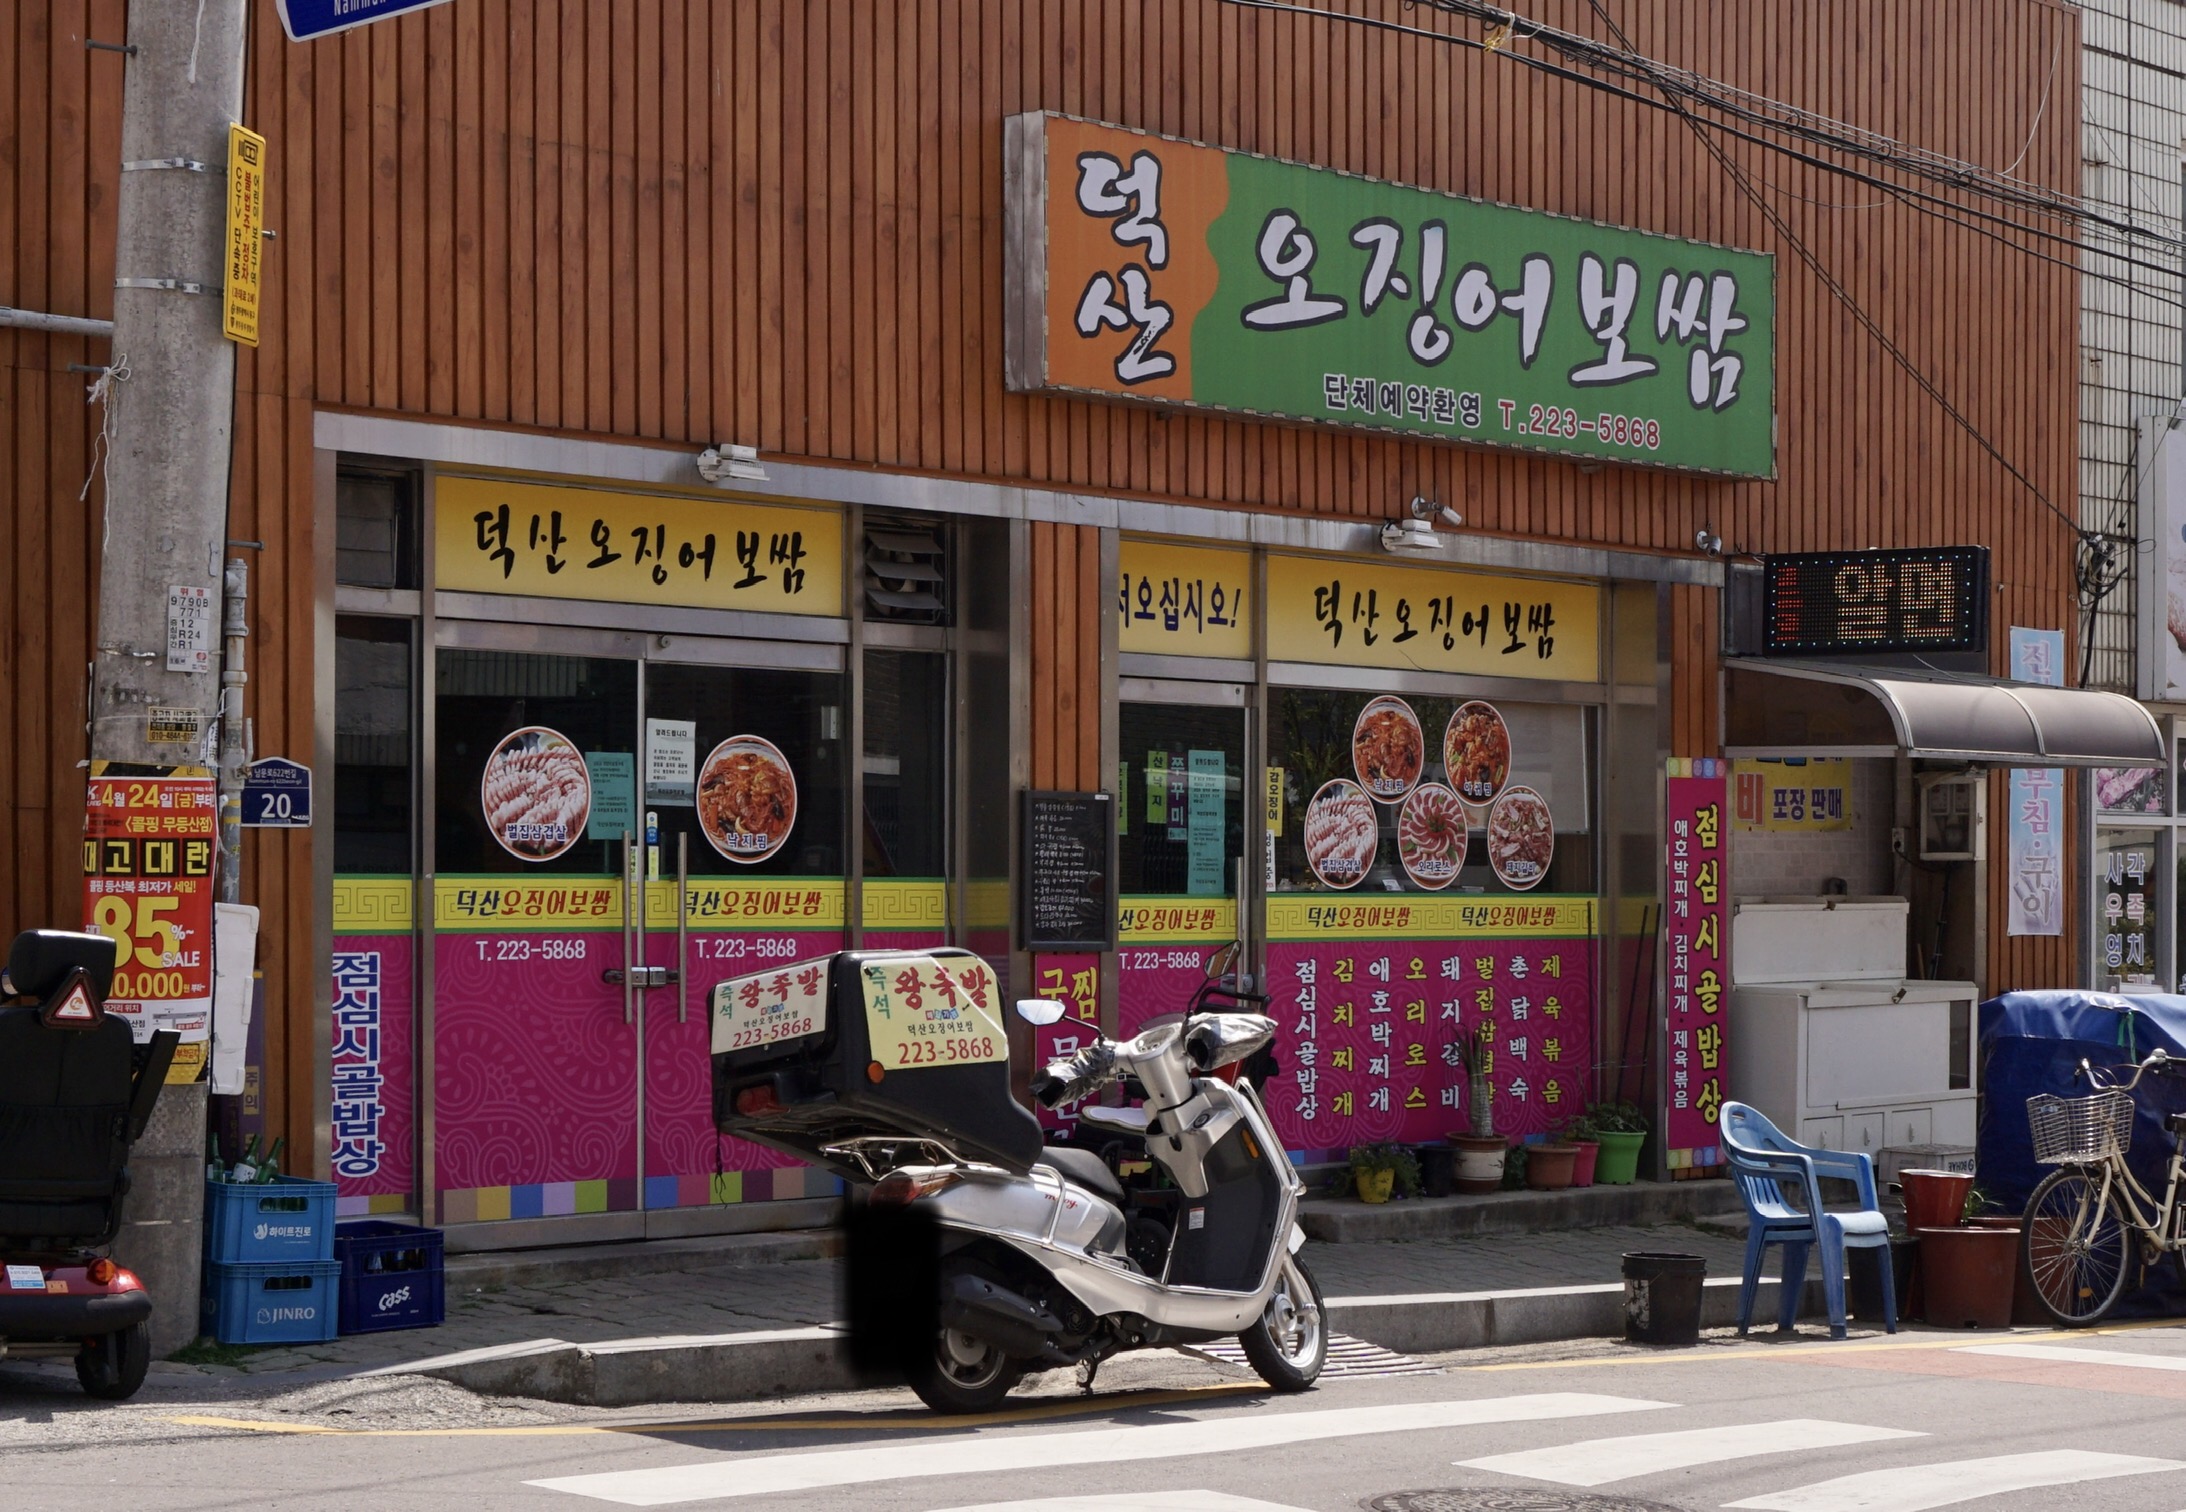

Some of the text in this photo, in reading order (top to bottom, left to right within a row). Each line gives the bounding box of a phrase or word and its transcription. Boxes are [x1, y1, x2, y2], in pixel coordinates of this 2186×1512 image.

[334, 0, 387, 17] Namm
[234, 166, 243, 219] CCTV
[1323, 373, 1481, 428] 단체예약환영
[179, 607, 201, 618] 771
[261, 793, 291, 818] 20
[1773, 788, 1842, 821] 포장 판매
[507, 823, 567, 841] 벌집삼겹살
[162, 951, 200, 968] SALE
[1693, 802, 1723, 1125] 점심시골밥상
[732, 1017, 812, 1048] 223-5868
[1332, 957, 1355, 1117] 김치찌개
[1368, 956, 1392, 1113] 애호박찌개
[1405, 956, 1427, 1109] 오리로스
[332, 952, 385, 1178] 점심시골밥상
[898, 1036, 994, 1065] 223-5868
[269, 1226, 312, 1238] 하이트진로
[272, 1307, 316, 1324] JINRO
